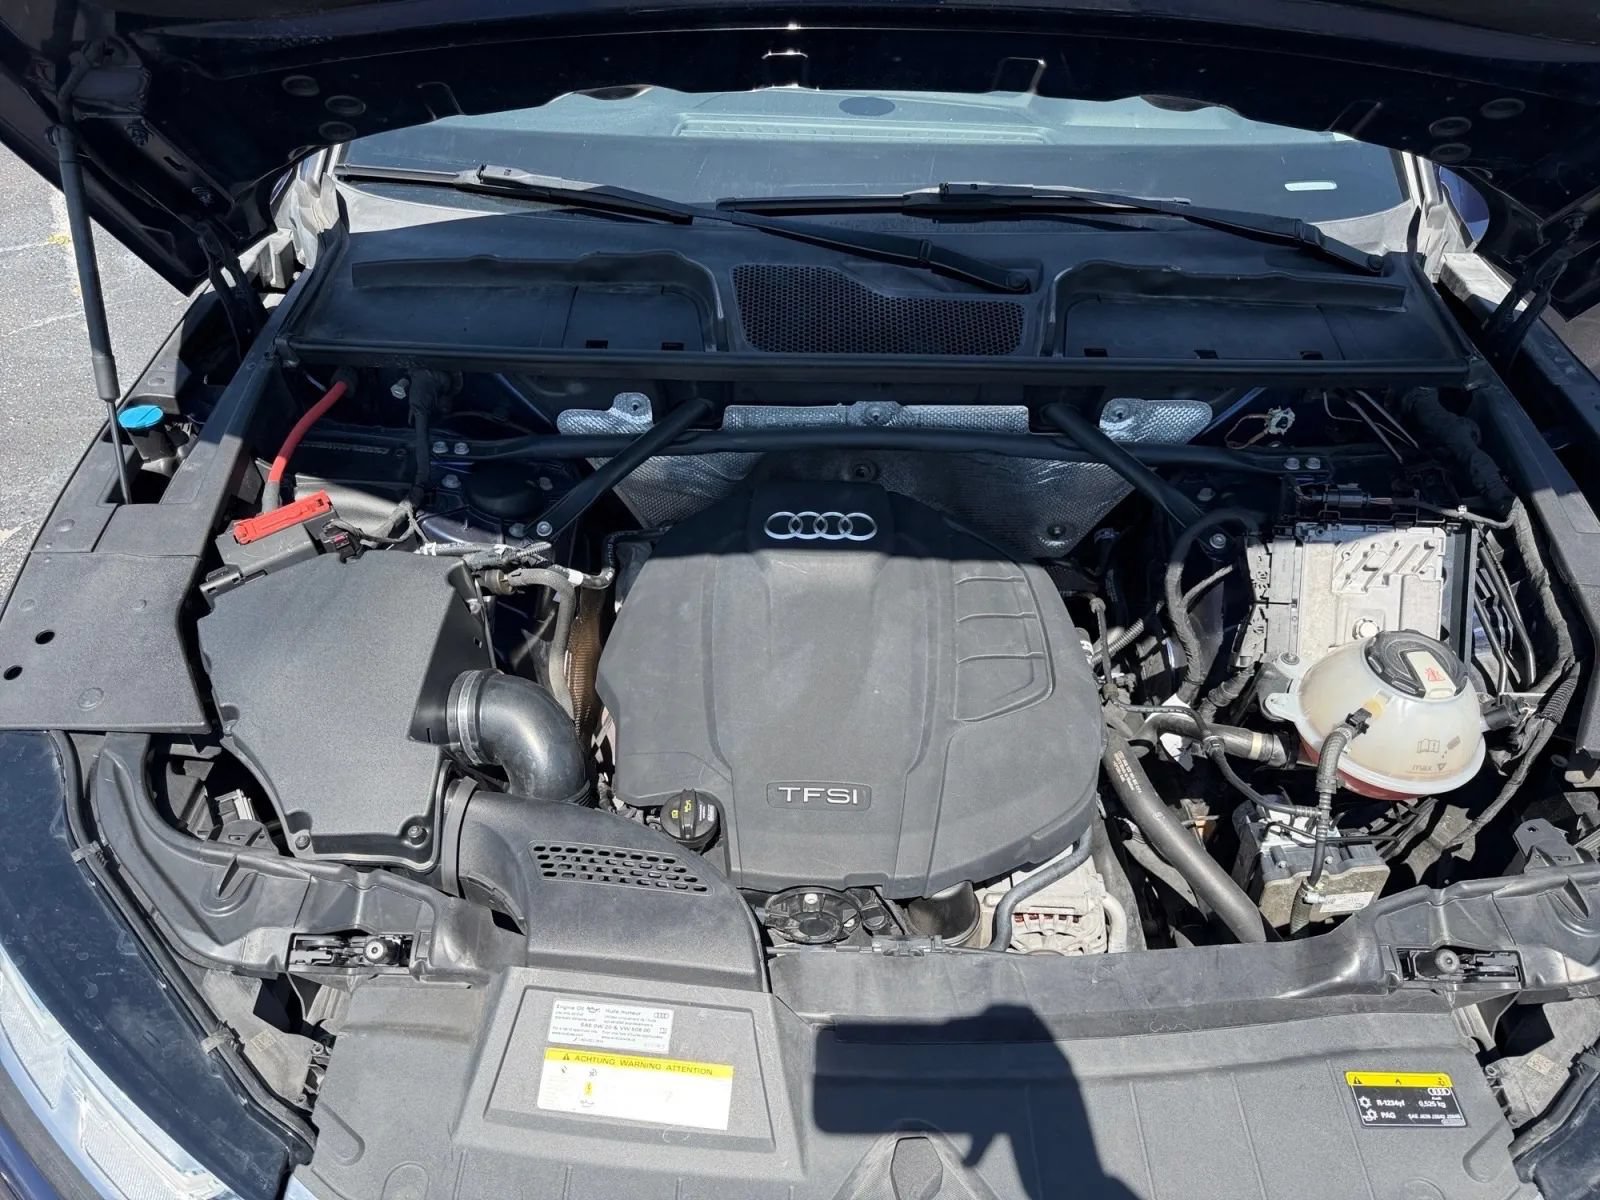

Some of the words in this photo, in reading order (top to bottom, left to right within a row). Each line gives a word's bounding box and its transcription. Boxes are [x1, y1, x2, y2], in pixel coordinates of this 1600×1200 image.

[778, 786, 857, 804] TFSI
[574, 1054, 616, 1066] ACHTUNG
[619, 1059, 662, 1071] WARNING
[665, 1065, 713, 1076] ATTENTION
[1437, 1101, 1447, 1109] kg
[1381, 1111, 1396, 1119] PAG
